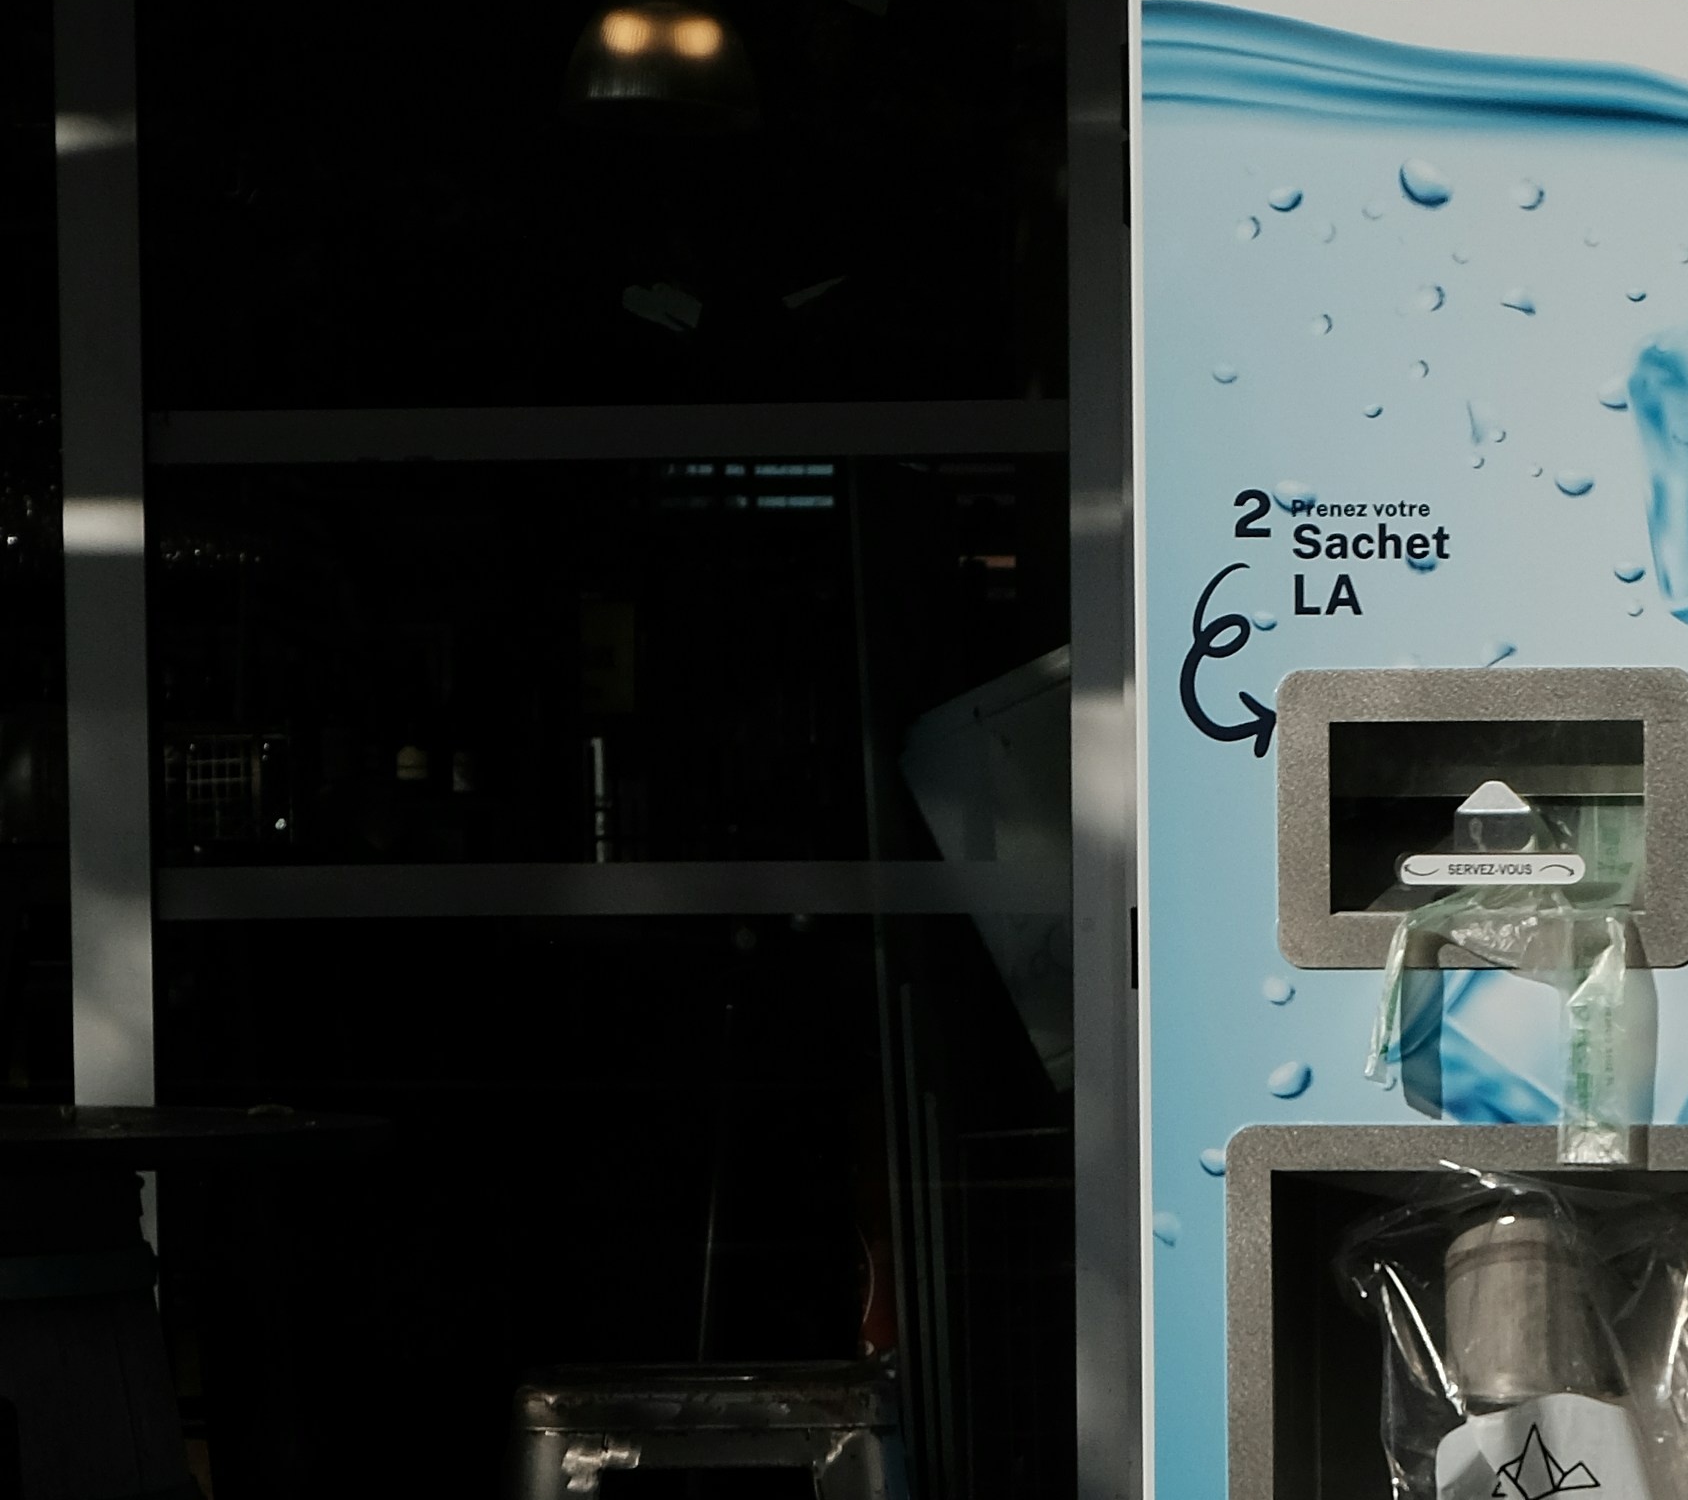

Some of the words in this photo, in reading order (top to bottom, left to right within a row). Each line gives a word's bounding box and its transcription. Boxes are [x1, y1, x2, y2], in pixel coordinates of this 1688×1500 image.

[1233, 489, 1272, 538] 2
[1291, 499, 1368, 518] Prenez
[1373, 500, 1431, 518] votre
[1292, 522, 1450, 560] Sachet
[1294, 573, 1363, 616] LA
[1448, 863, 1533, 876] SERVEZ-VOUS
